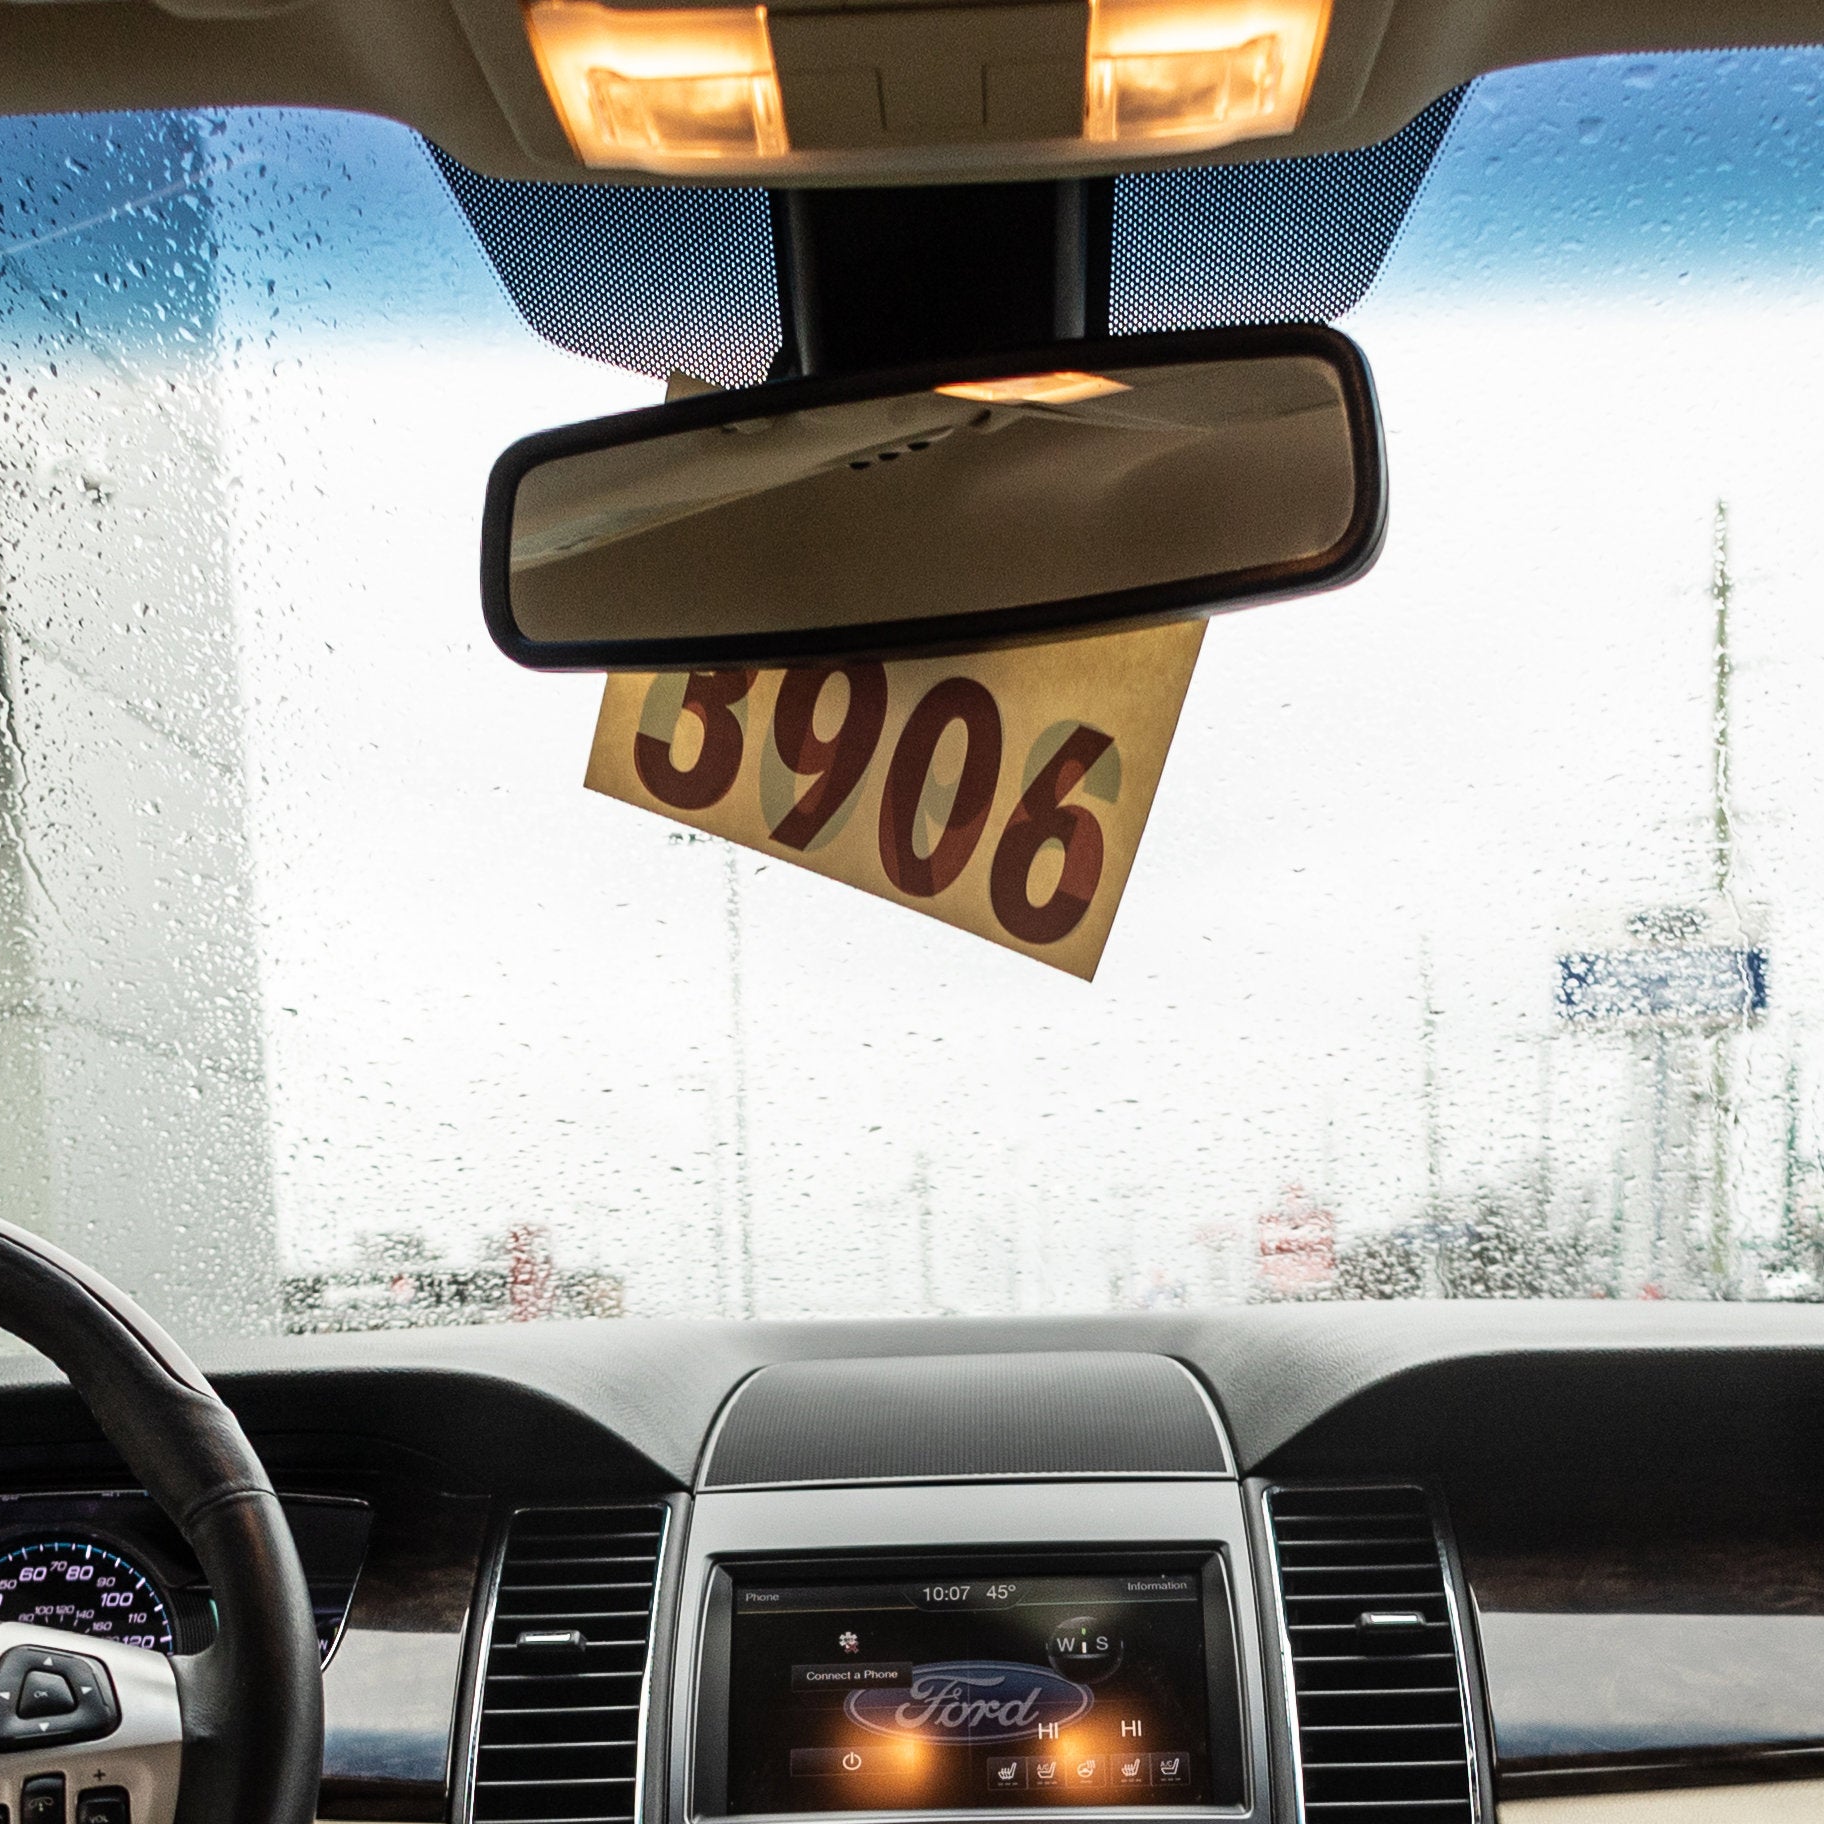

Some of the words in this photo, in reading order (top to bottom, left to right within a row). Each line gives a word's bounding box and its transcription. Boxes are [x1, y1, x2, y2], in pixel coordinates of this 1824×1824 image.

[633, 660, 1116, 945] 3906
[49, 1560, 68, 1572] 70
[65, 1565, 94, 1581] 80
[18, 1566, 47, 1582] 60
[923, 1585, 971, 1602] 10:07
[1127, 1580, 1188, 1592] Information
[100, 1592, 134, 1607] 100
[745, 1592, 780, 1603] Phone
[128, 1612, 148, 1624] 110
[1056, 1637, 1076, 1653] W
[1095, 1636, 1109, 1651] S
[806, 1670, 852, 1682] Connect
[853, 1672, 861, 1680] a
[863, 1669, 899, 1680] Phone
[895, 1675, 1042, 1729] Ford
[1037, 1722, 1059, 1740] HI
[1120, 1719, 1142, 1738] HI
[89, 1815, 109, 1824] VOL
